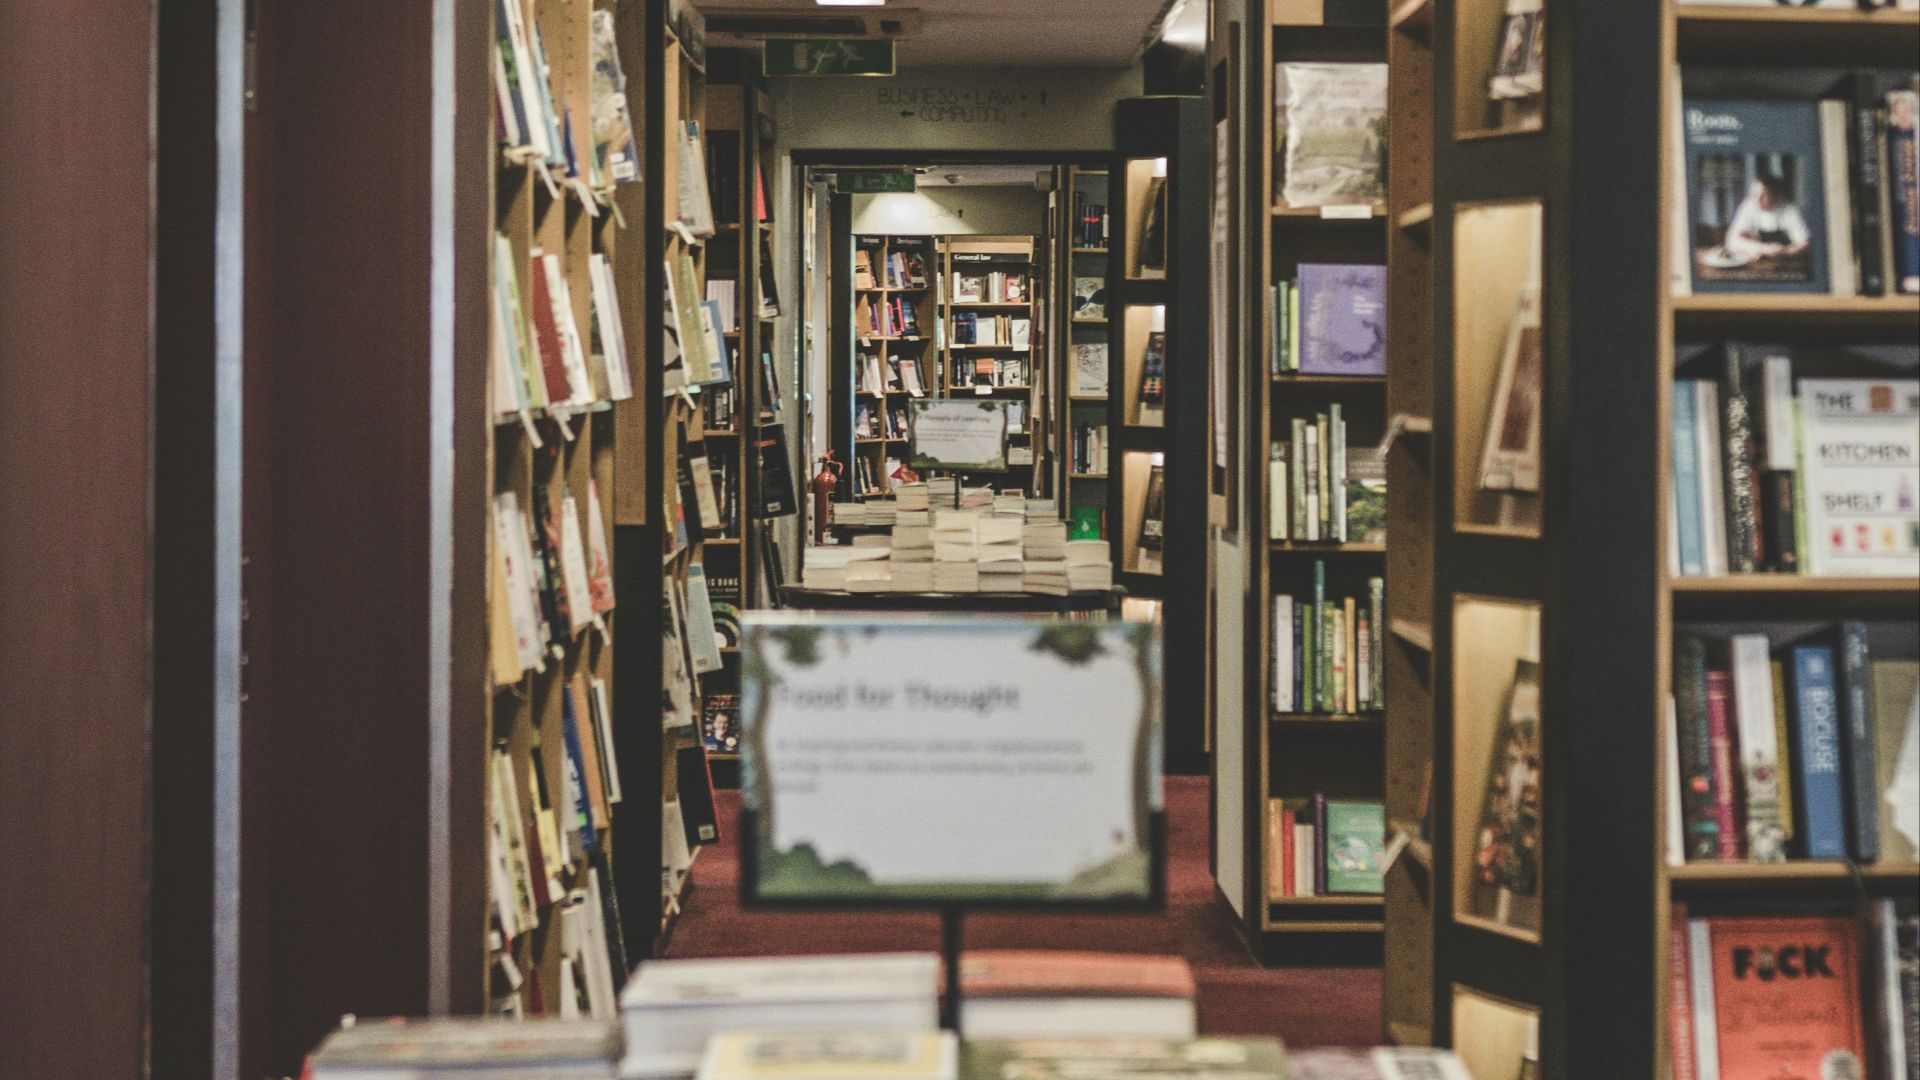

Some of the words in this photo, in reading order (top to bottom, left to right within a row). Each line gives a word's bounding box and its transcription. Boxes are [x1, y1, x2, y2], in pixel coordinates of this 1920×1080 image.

[878, 87, 960, 105] BUSINESS
[954, 253, 980, 261] General
[1816, 392, 1854, 410] THE
[1820, 443, 1911, 461] KITCHEN
[1824, 493, 1883, 510] SHELF
[853, 683, 895, 711] for
[903, 682, 1020, 718] Thought
